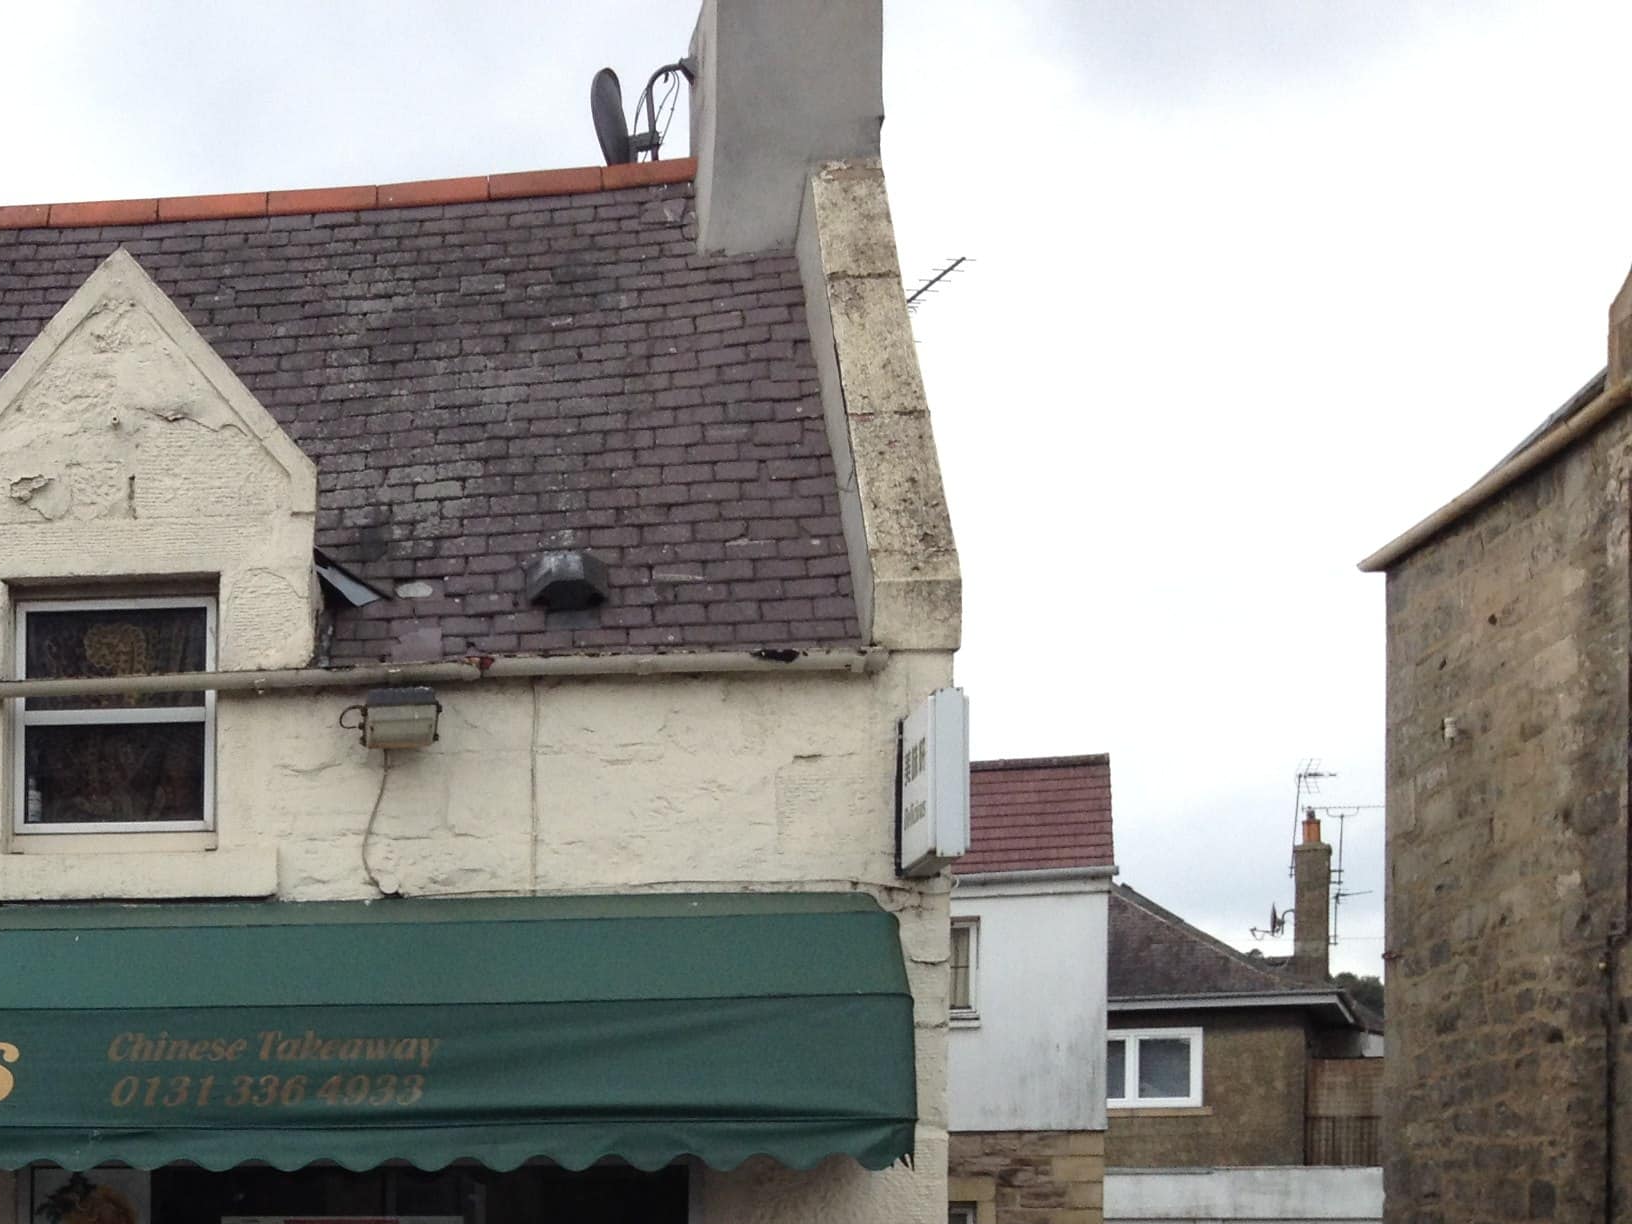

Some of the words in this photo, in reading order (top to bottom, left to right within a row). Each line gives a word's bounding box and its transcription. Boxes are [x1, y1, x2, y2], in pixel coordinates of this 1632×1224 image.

[108, 1031, 248, 1062] Chinese
[258, 1030, 440, 1068] Takeaway
[111, 1075, 215, 1107] 0131
[224, 1075, 308, 1107] 336
[318, 1074, 426, 1107] 4933
